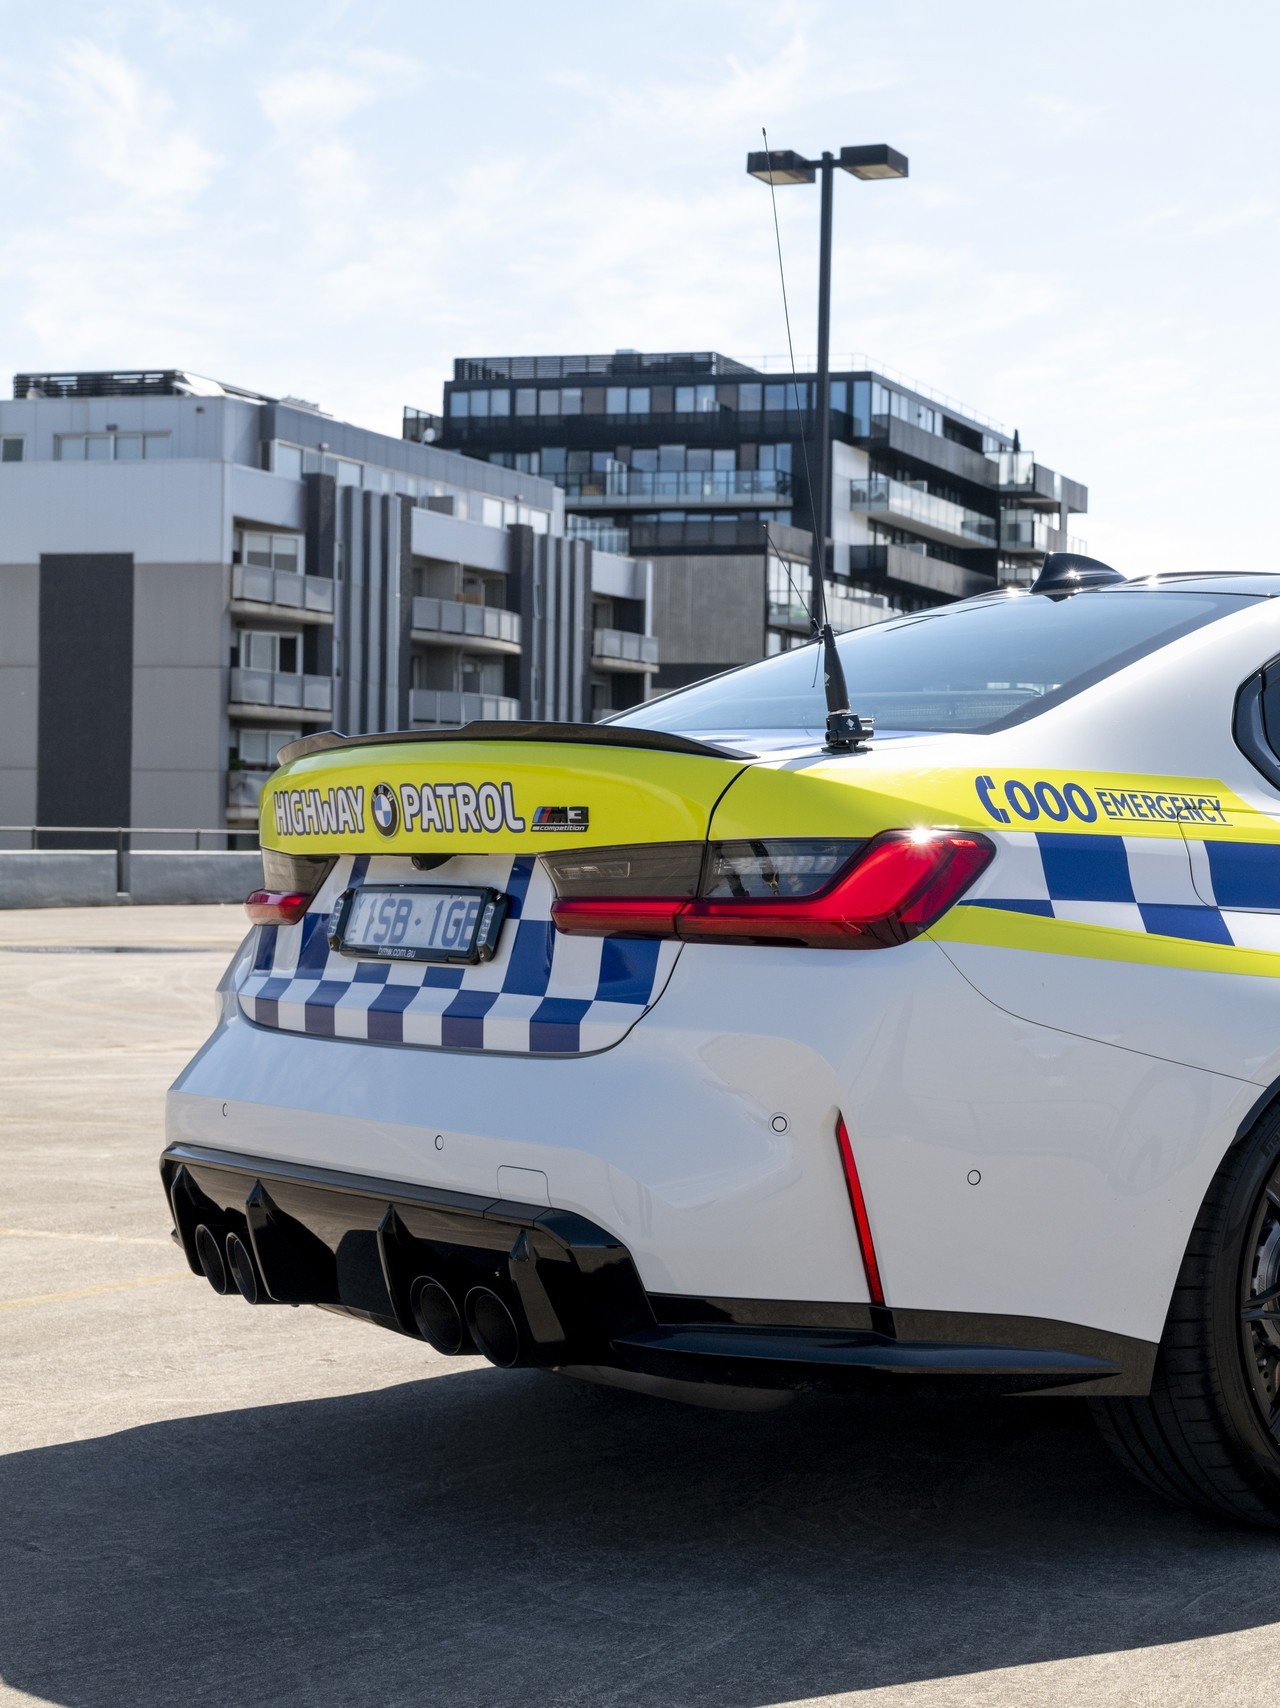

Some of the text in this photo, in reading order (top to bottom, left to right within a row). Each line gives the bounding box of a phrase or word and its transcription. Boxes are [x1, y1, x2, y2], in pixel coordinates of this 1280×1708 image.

[273, 782, 525, 836] HIGHWAY PATROL
[1004, 779, 1228, 823] 000 EMERGENCY
[550, 806, 589, 823] M3
[537, 825, 586, 833] competition
[377, 945, 417, 959] bmw.com.au
